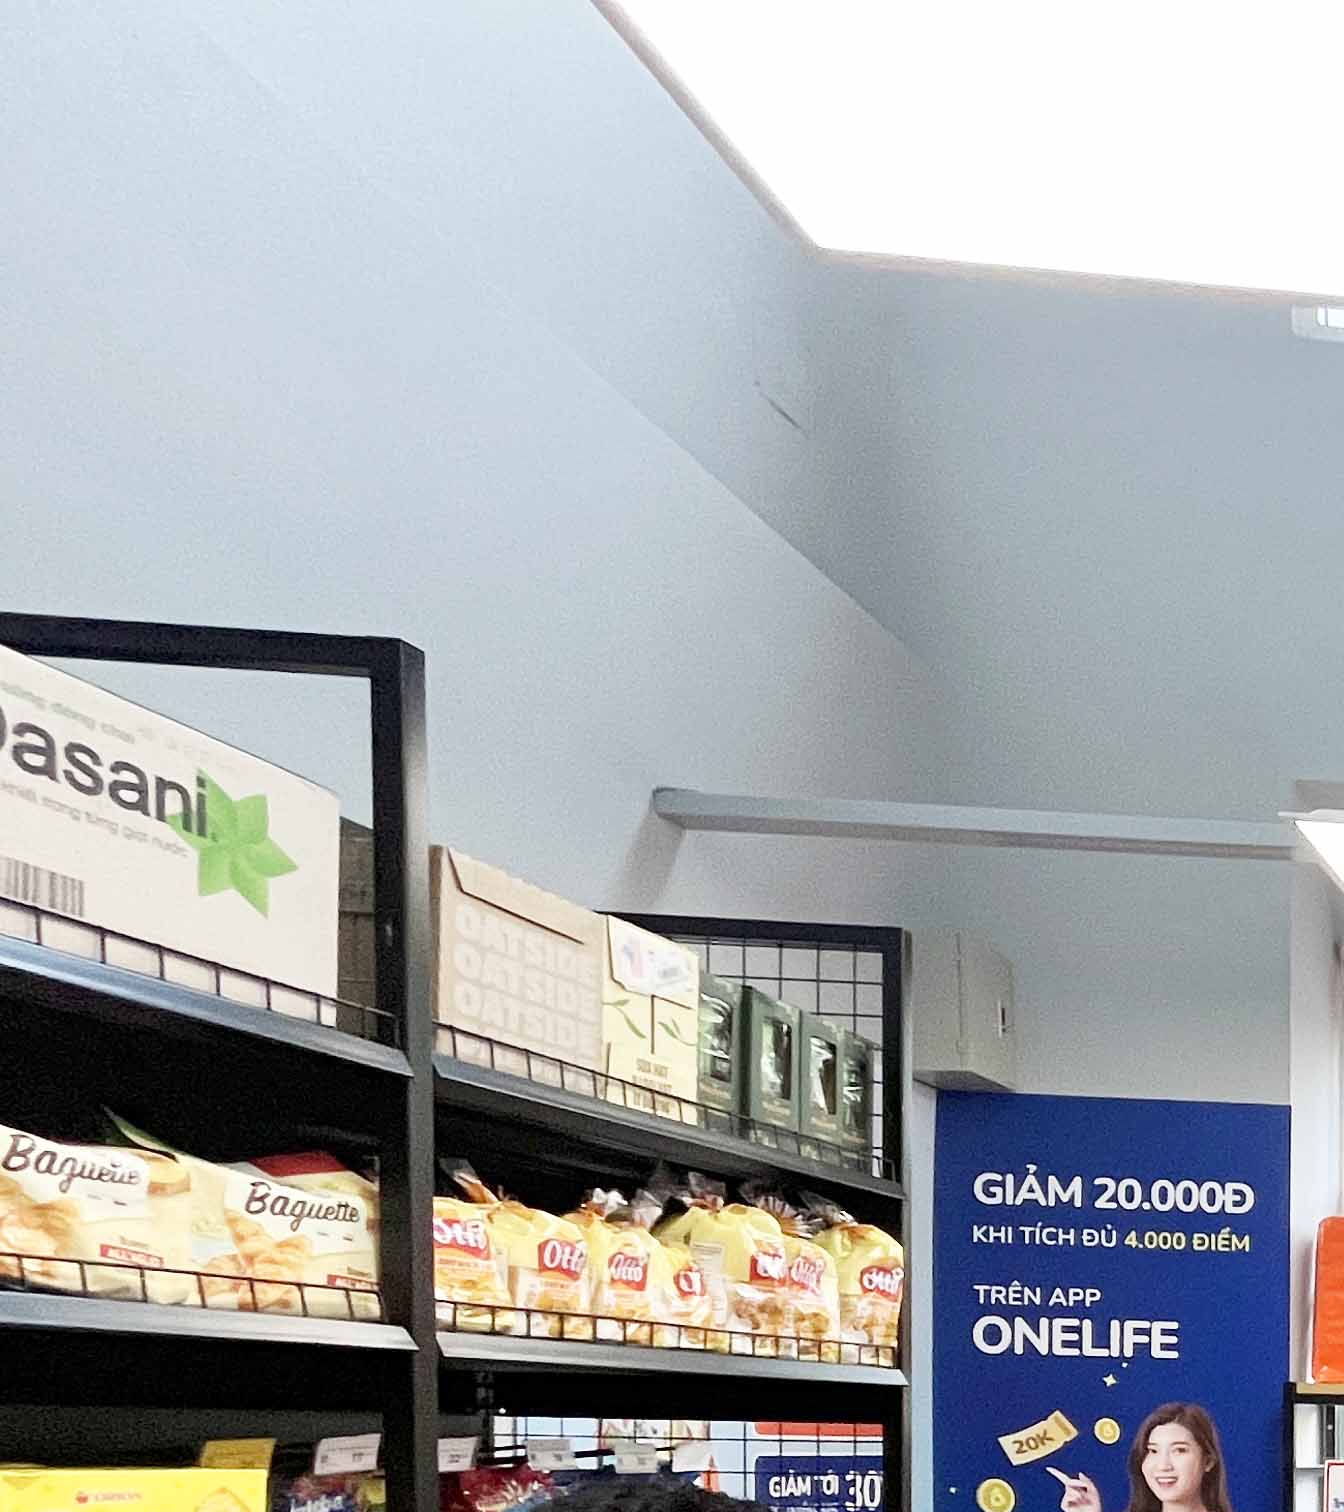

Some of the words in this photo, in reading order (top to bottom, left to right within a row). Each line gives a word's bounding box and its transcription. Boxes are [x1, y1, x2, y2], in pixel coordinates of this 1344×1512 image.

[0, 704, 207, 838] asani
[1, 1133, 139, 1193] Baguette
[245, 1181, 360, 1231] Baguette
[973, 1164, 1082, 1208] GIẢM
[1093, 1177, 1255, 1214] 20.000Đ
[972, 1225, 1012, 1244] KHI
[1020, 1222, 1075, 1246] TÍCH
[1082, 1223, 1117, 1248] ĐỦ
[1124, 1231, 1186, 1250] 4.000
[1192, 1226, 1250, 1252] ĐIỂM
[973, 1280, 1041, 1306] TRÊN
[1049, 1288, 1101, 1307] APP
[972, 1315, 1179, 1359] ONELIFE
[1012, 1429, 1056, 1455] 20K
[768, 1469, 812, 1497] GIẢM
